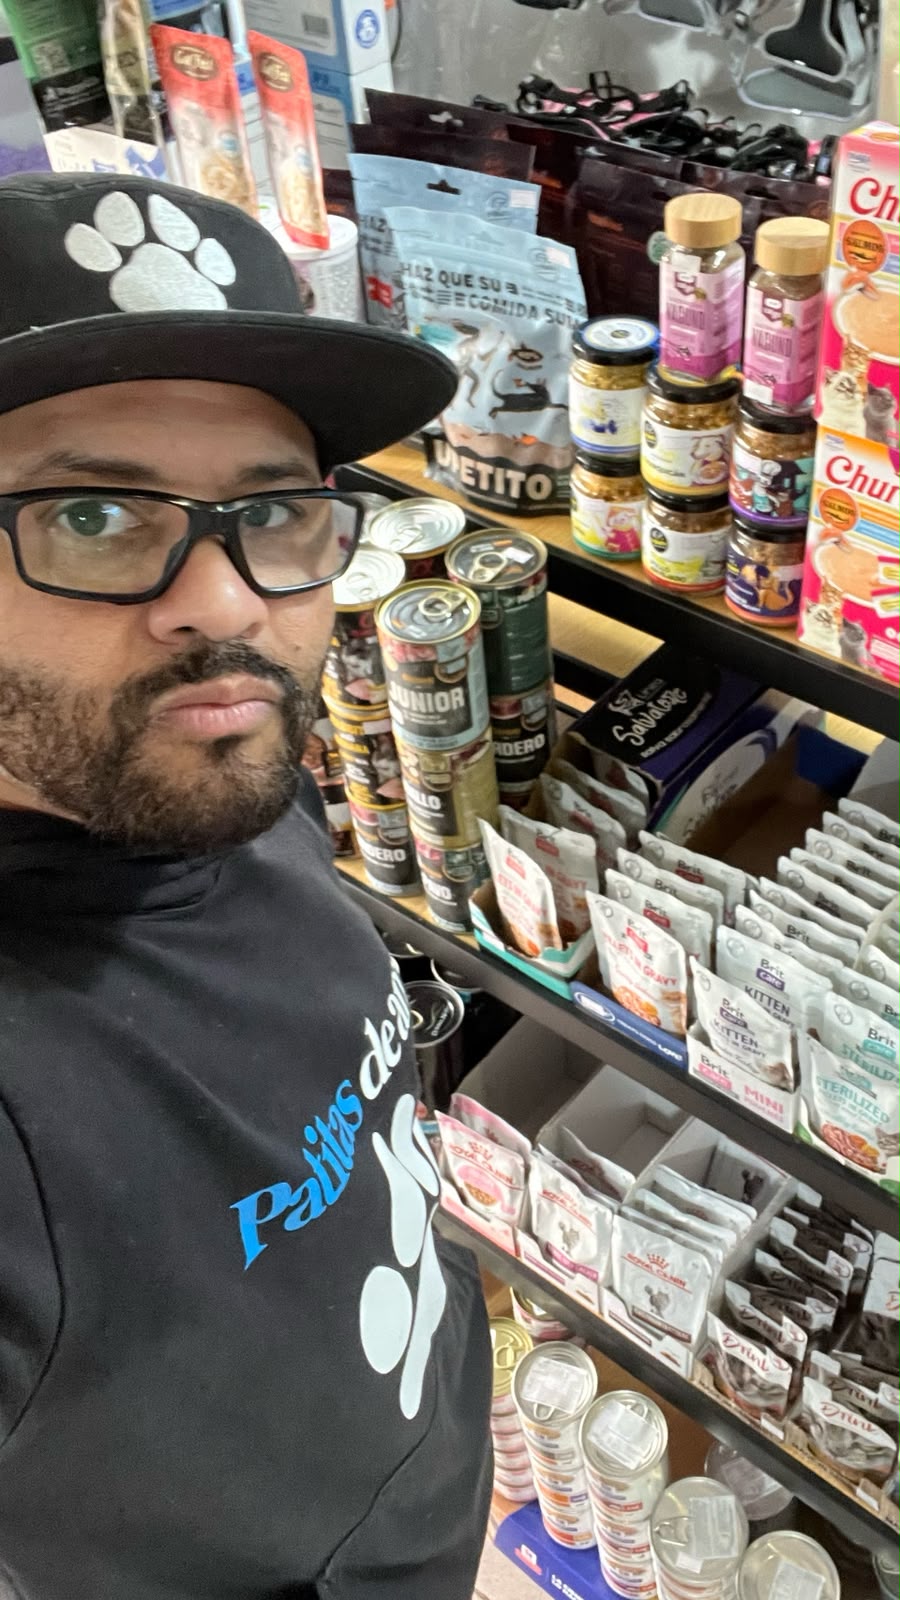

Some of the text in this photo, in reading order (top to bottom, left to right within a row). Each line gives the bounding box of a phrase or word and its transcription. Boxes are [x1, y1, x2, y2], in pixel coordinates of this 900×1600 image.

[849, 177, 900, 222] Ch
[401, 262, 433, 282] HAZ
[438, 269, 475, 289] QUE
[468, 292, 540, 321] COMIDA
[388, 680, 466, 714] JUNIOR
[492, 733, 546, 757] RDERO
[677, 859, 702, 875] Brit
[760, 957, 785, 979] Brit
[722, 997, 745, 1019] Brit
[744, 985, 792, 1018] KITTEN
[713, 1018, 759, 1049] KITTEN
[867, 1027, 897, 1049] Brit
[701, 1054, 730, 1078] Brit
[744, 1084, 784, 1115] MINI
[229, 1079, 364, 1271] Patitas
[359, 1016, 402, 1101] de
